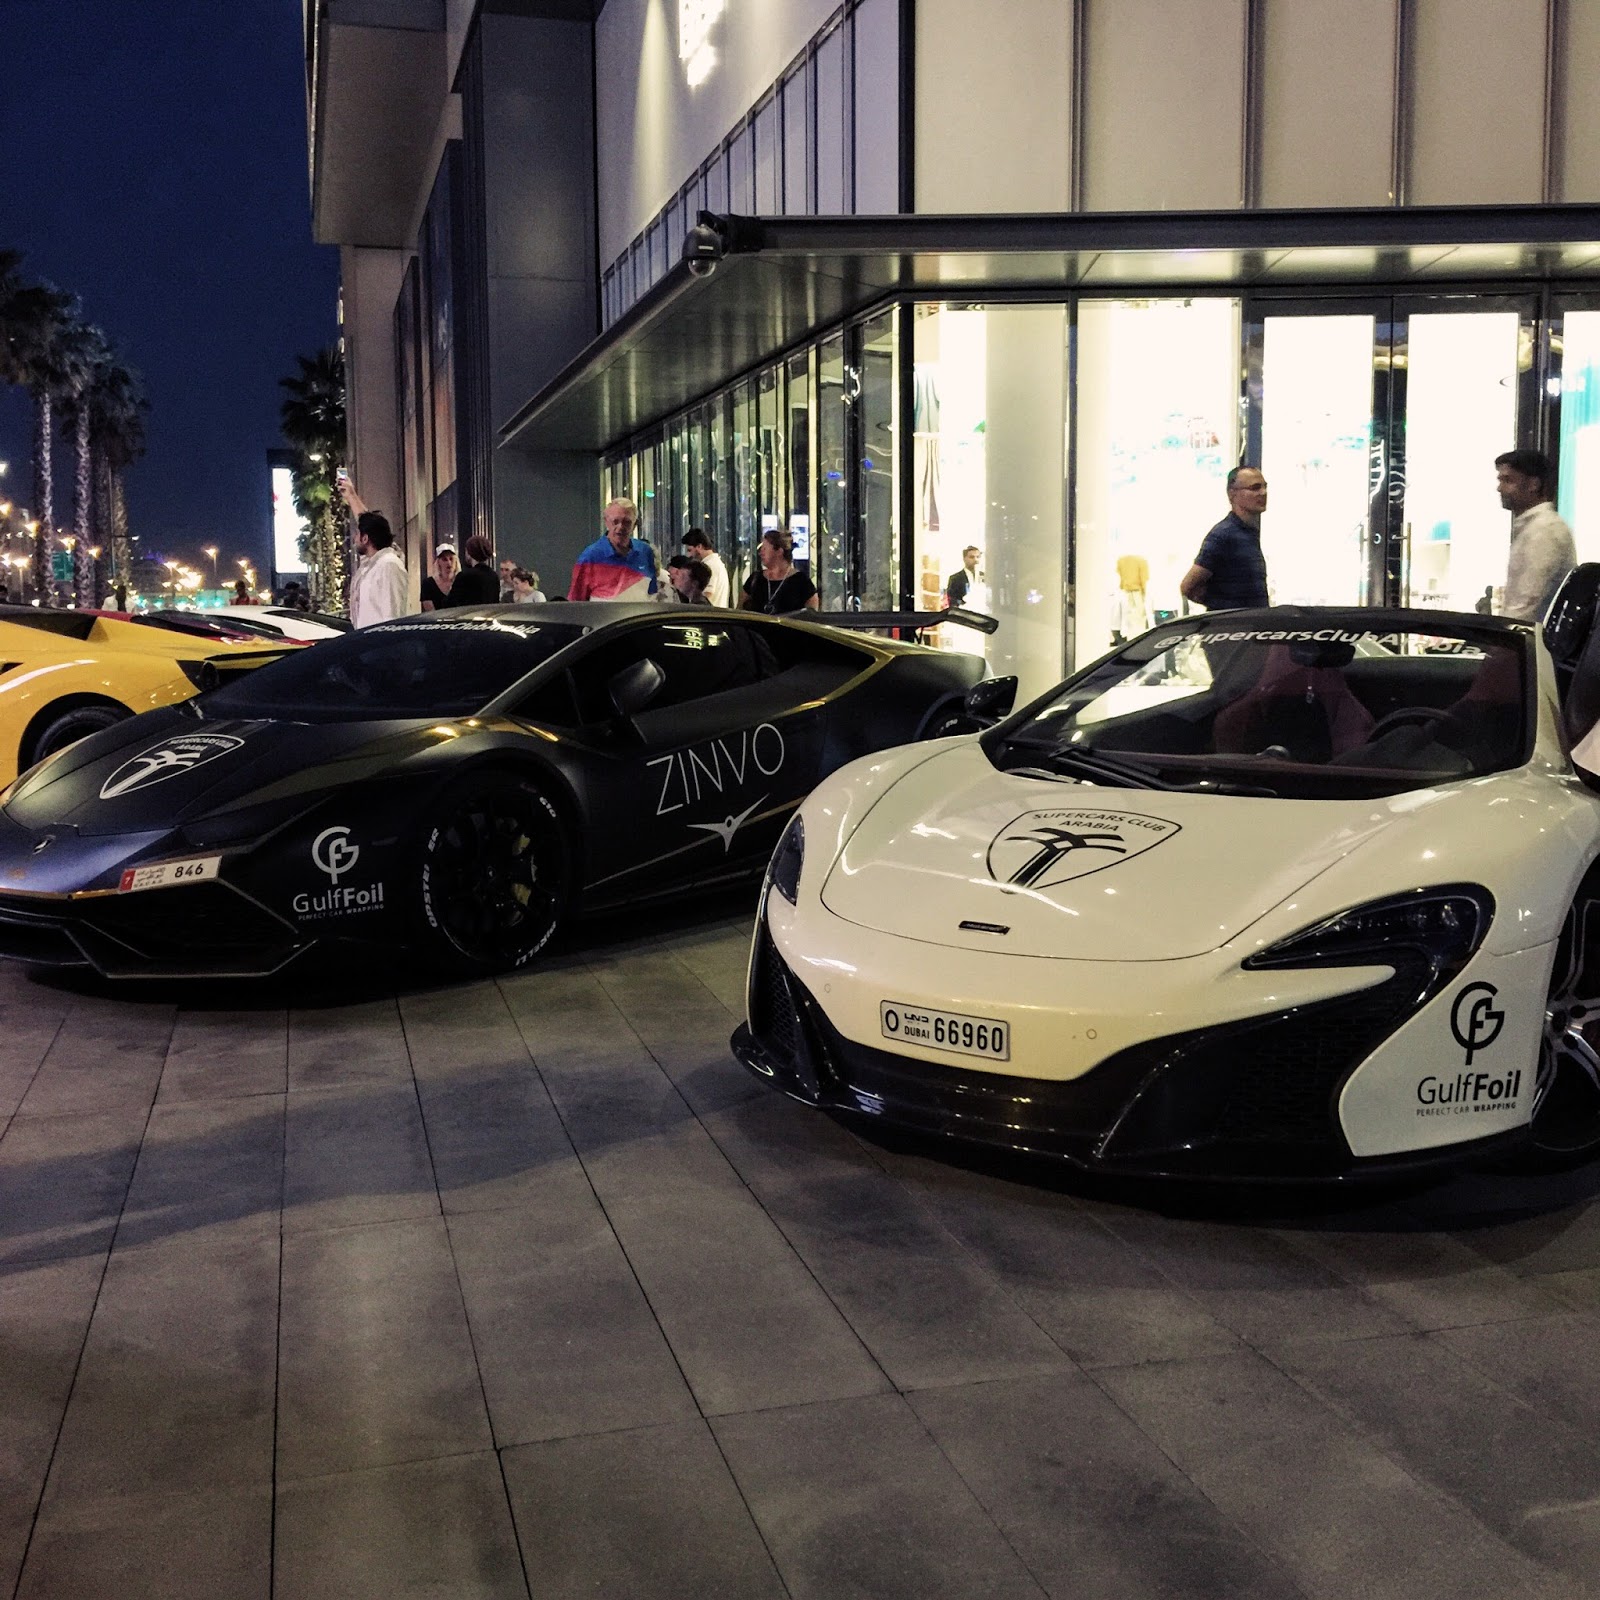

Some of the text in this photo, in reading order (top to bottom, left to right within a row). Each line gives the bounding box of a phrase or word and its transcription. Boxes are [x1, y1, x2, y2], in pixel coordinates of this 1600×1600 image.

[646, 722, 785, 816] ZINVO
[1032, 812, 1166, 832] SUPERCARS CLUB
[1059, 820, 1120, 832] ARABIA
[174, 863, 204, 878] 846
[292, 882, 384, 913] GulfFoil
[346, 904, 385, 914] WRAPPING
[904, 1025, 930, 1039] DUBAI
[934, 1017, 1003, 1053] 66960
[1417, 1069, 1522, 1105] GulfFoil
[1416, 1101, 1517, 1117] PERFECT CAR WRAPPING
